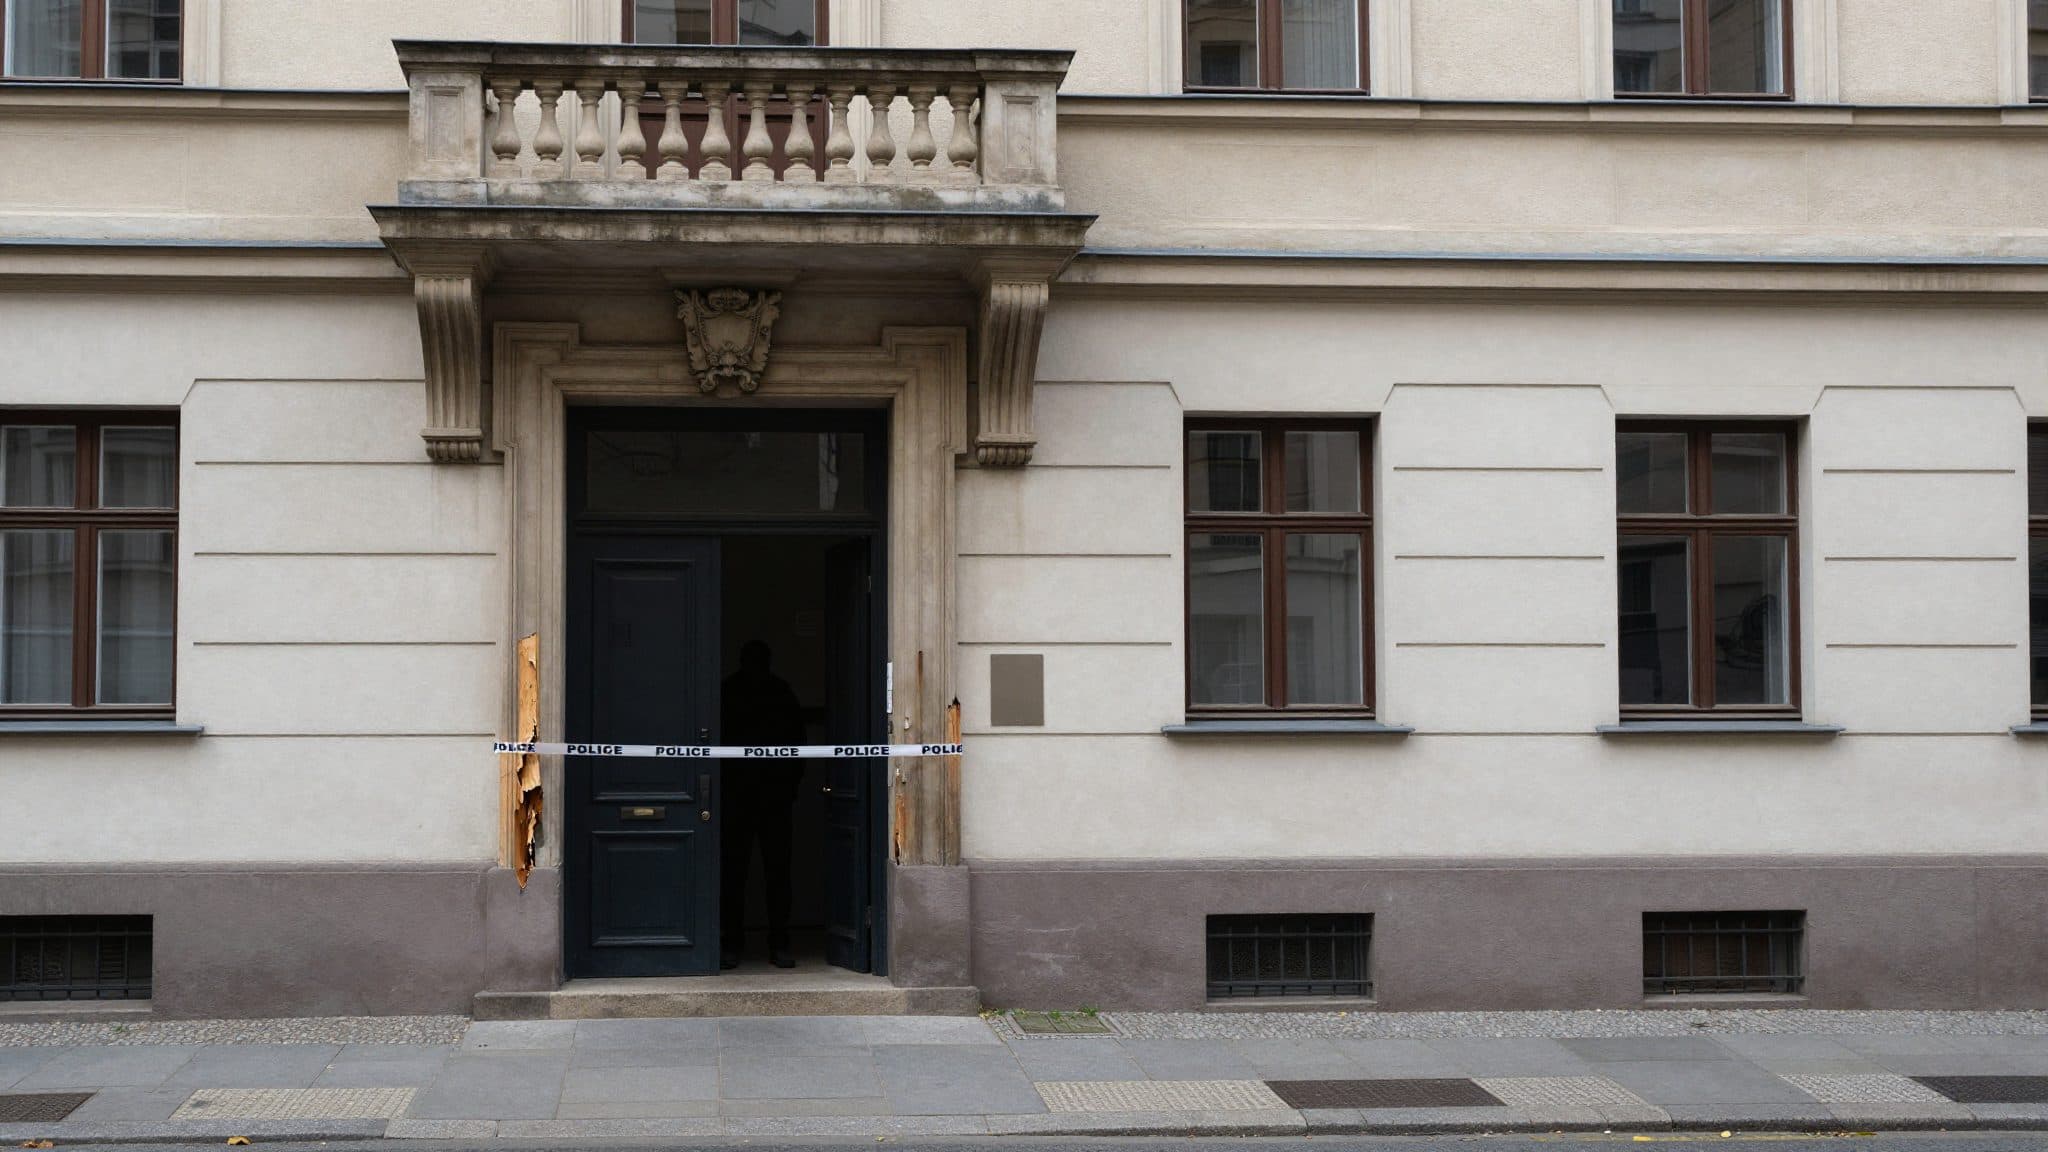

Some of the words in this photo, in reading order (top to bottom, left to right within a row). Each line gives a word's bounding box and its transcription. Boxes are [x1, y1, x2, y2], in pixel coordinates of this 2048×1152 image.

[567, 745, 623, 755] POLICE
[655, 747, 711, 756] POLICE
[744, 748, 799, 757] POLICE
[834, 747, 889, 756] POLICE
